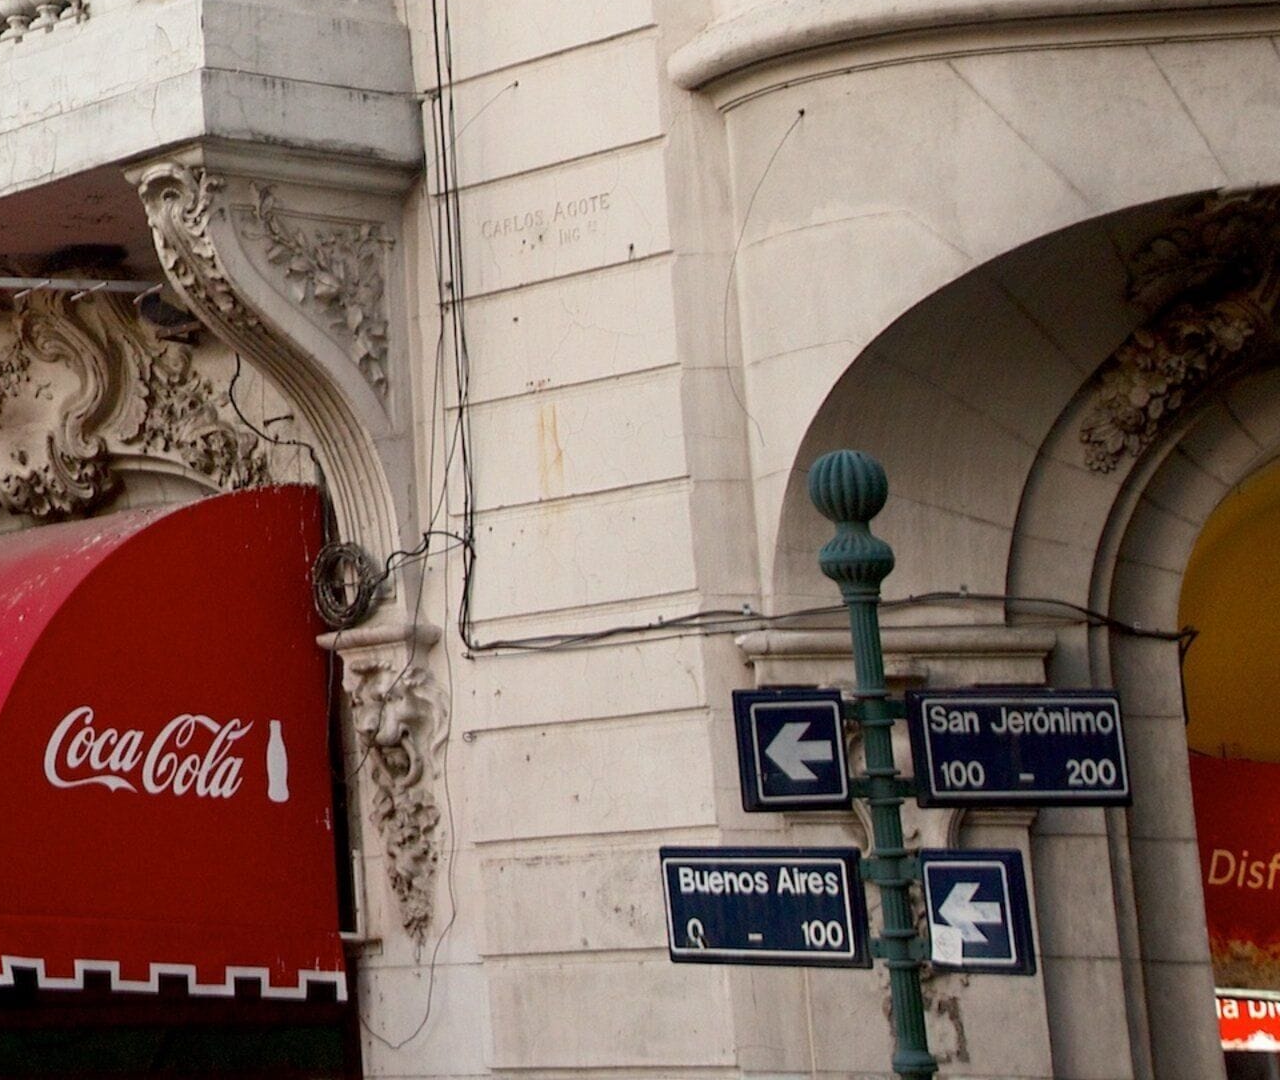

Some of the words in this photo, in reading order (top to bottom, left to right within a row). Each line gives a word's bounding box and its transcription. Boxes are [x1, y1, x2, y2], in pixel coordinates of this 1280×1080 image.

[481, 210, 543, 238] CARLOS
[554, 192, 610, 223] AGOTE
[930, 705, 980, 734] San
[990, 706, 1115, 735] Jerónimo
[940, 760, 985, 788] 100
[1065, 758, 1117, 786] 200
[678, 867, 770, 895] Buenos
[776, 867, 840, 896] Aires
[801, 920, 844, 948] 100
